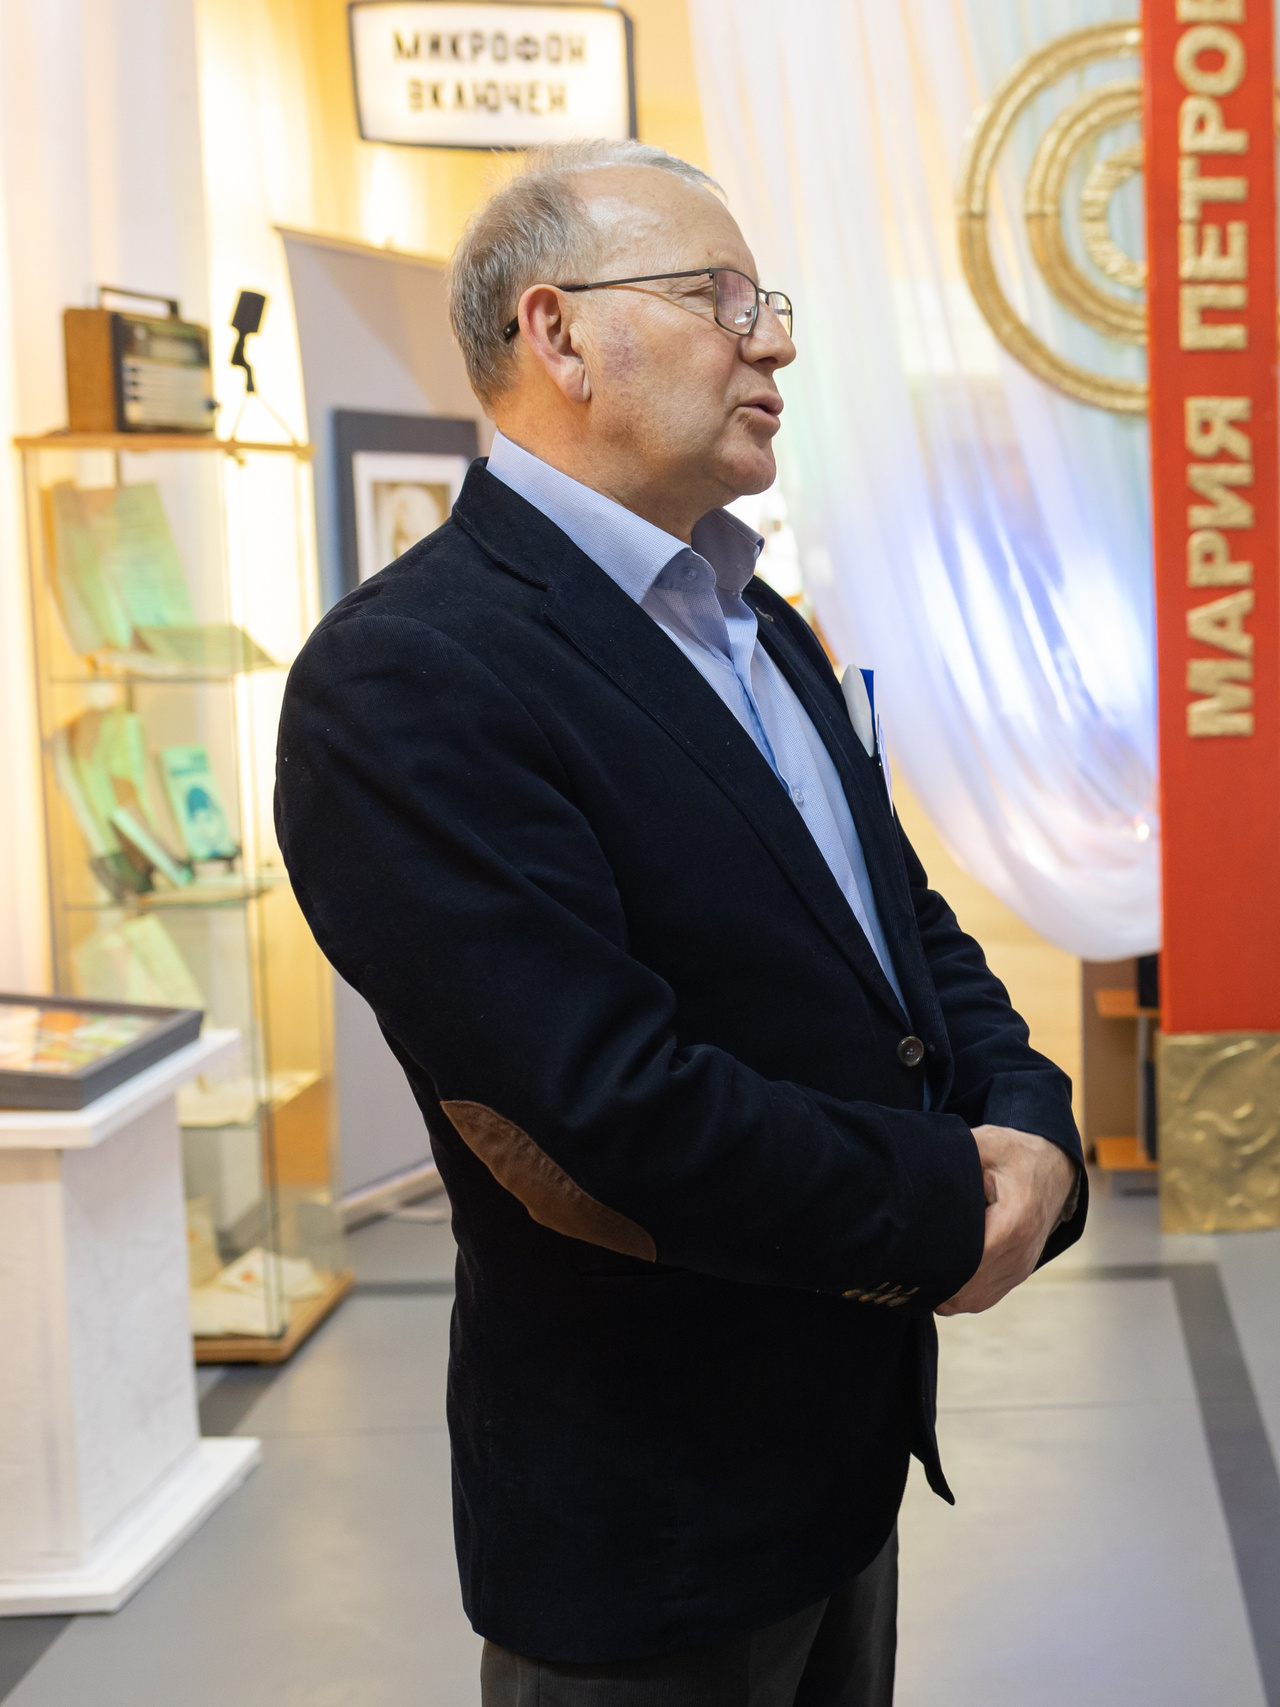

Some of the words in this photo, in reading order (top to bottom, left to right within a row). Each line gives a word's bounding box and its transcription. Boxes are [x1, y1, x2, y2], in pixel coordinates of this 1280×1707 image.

[394, 31, 587, 63] МИКРОФОН
[408, 78, 567, 113] ВКЛЮЧЕН
[1185, 396, 1254, 737] МАРИЯ
